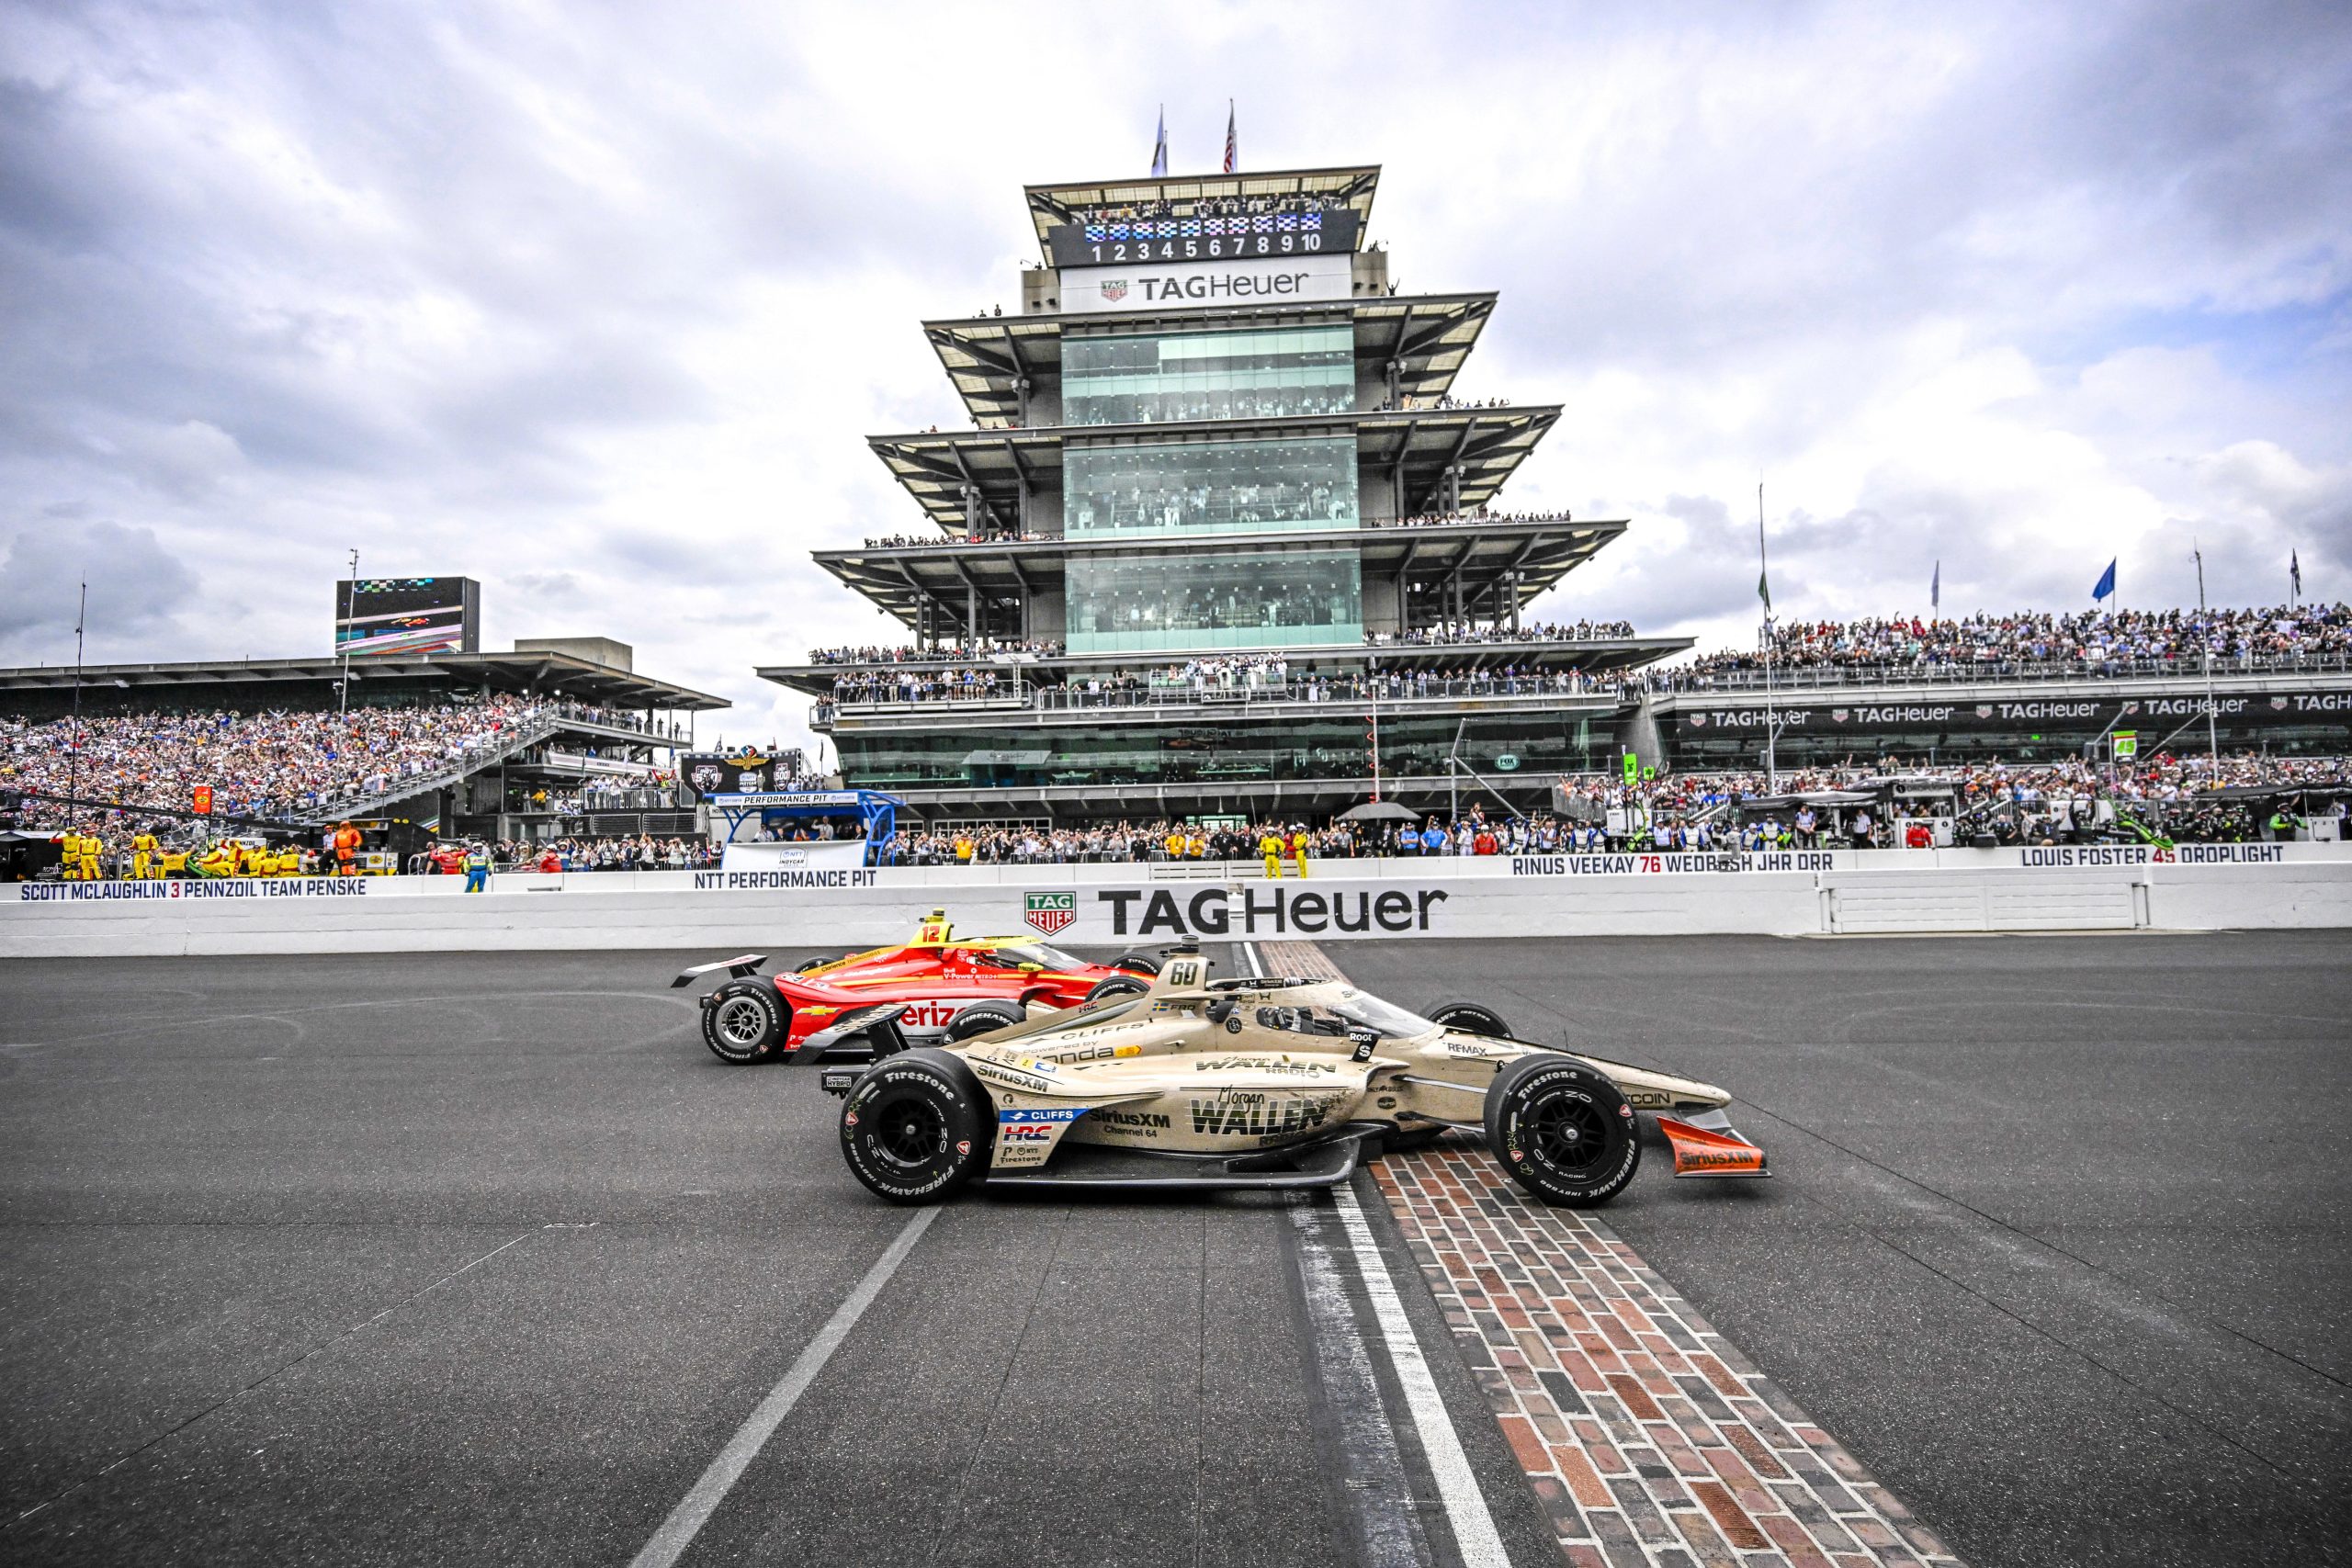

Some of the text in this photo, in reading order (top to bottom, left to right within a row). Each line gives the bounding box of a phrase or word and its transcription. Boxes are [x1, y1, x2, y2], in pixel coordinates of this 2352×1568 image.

[1091, 233, 1321, 262] 1 2 3 4 5 6 7 8 9 10
[1103, 280, 1125, 289] TAG
[1499, 758, 1514, 766] FOX
[775, 772, 788, 780] 500
[744, 795, 810, 805] PERFORMANCE
[1512, 853, 1833, 875] RINUS VEEKAY 76 WEDBSH JHR DRR
[2022, 845, 2283, 866] LOUIS FOSTER 45 DROPLIGHT
[695, 869, 876, 889] NTT PERFORMANCE PIT
[21, 878, 367, 900] SCOTT MCLAUGHLIN 3 PENNZOIL TEAM PENSKE
[1029, 896, 1071, 908] TAG
[1028, 910, 1074, 933] HEUER
[922, 926, 940, 942] 12
[821, 961, 845, 973] Clarience
[1170, 962, 1198, 986] 60
[751, 987, 778, 1025] Firestone
[900, 1001, 967, 1027] eriz
[1061, 1022, 1145, 1041] CLIFFS
[1350, 1032, 1372, 1042] Root
[1082, 1040, 1100, 1049] by
[1196, 1060, 1337, 1074] WALLEN
[1265, 1068, 1320, 1078] RADIO
[884, 1071, 955, 1100] Firestone
[977, 1065, 1049, 1093] SiriusXM
[1518, 1071, 1577, 1100] Firestone
[1218, 1084, 1264, 1113] Morgan
[1031, 1111, 1074, 1120] CLIFFS
[1089, 1109, 1170, 1128] SiriusXM
[1190, 1098, 1329, 1136] WALLEN
[1003, 1125, 1053, 1141] HRC
[1103, 1125, 1157, 1138] Channel 64
[1679, 1151, 1754, 1165] SiriusXM
[1589, 1138, 1635, 1198] FIREHAWK
[877, 1165, 956, 1196] FIREHAWK
